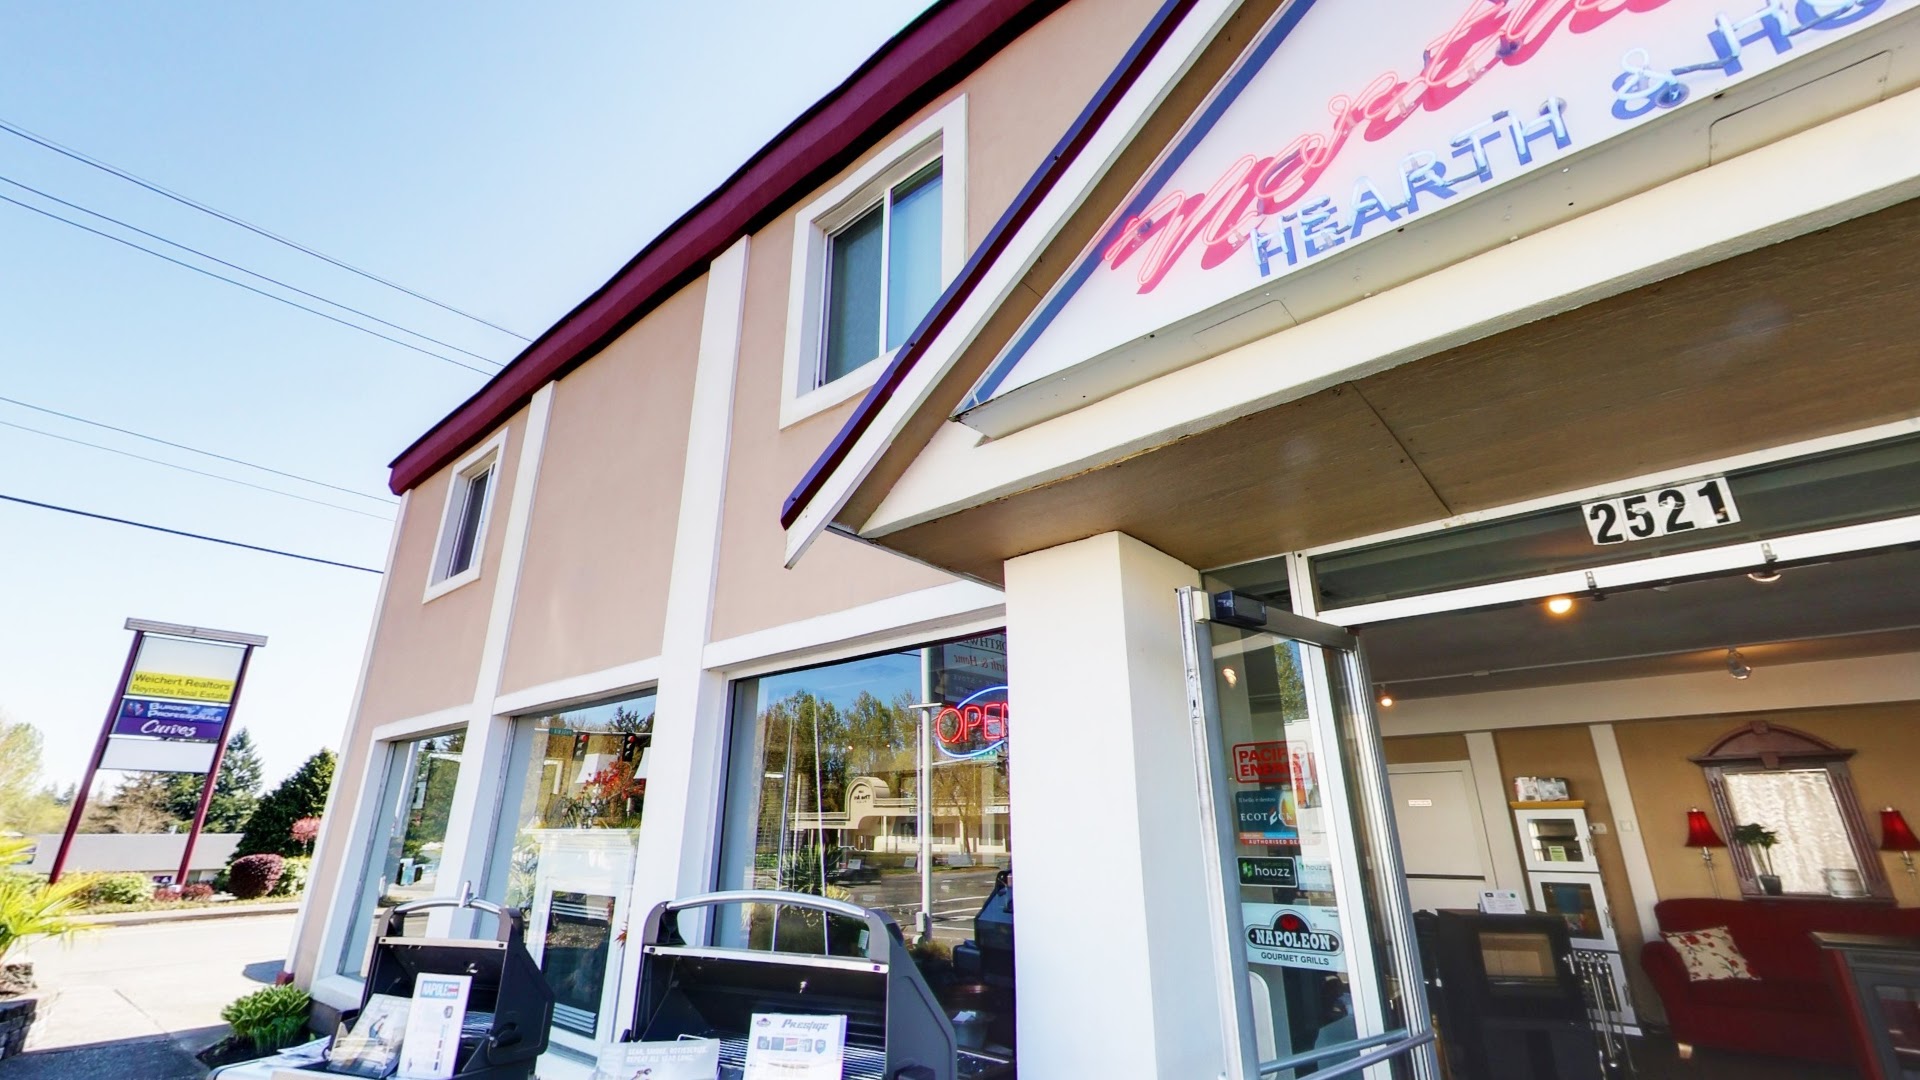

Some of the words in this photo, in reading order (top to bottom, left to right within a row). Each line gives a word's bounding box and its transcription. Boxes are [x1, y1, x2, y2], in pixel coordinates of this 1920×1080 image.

[1251, 96, 1573, 277] HEARTH
[1611, 48, 1690, 120] &
[1589, 480, 1731, 545] 2521
[135, 674, 182, 685] Weichert
[186, 679, 230, 690] Realtors
[177, 689, 198, 697] Real
[201, 691, 228, 699] Estate
[141, 720, 197, 737] Curves
[1238, 746, 1304, 763] PACIFC
[1254, 864, 1291, 877] houzz
[1255, 928, 1331, 951] NAPOLEON
[1261, 951, 1298, 963] GOURMET
[1300, 955, 1330, 966] GRILLS
